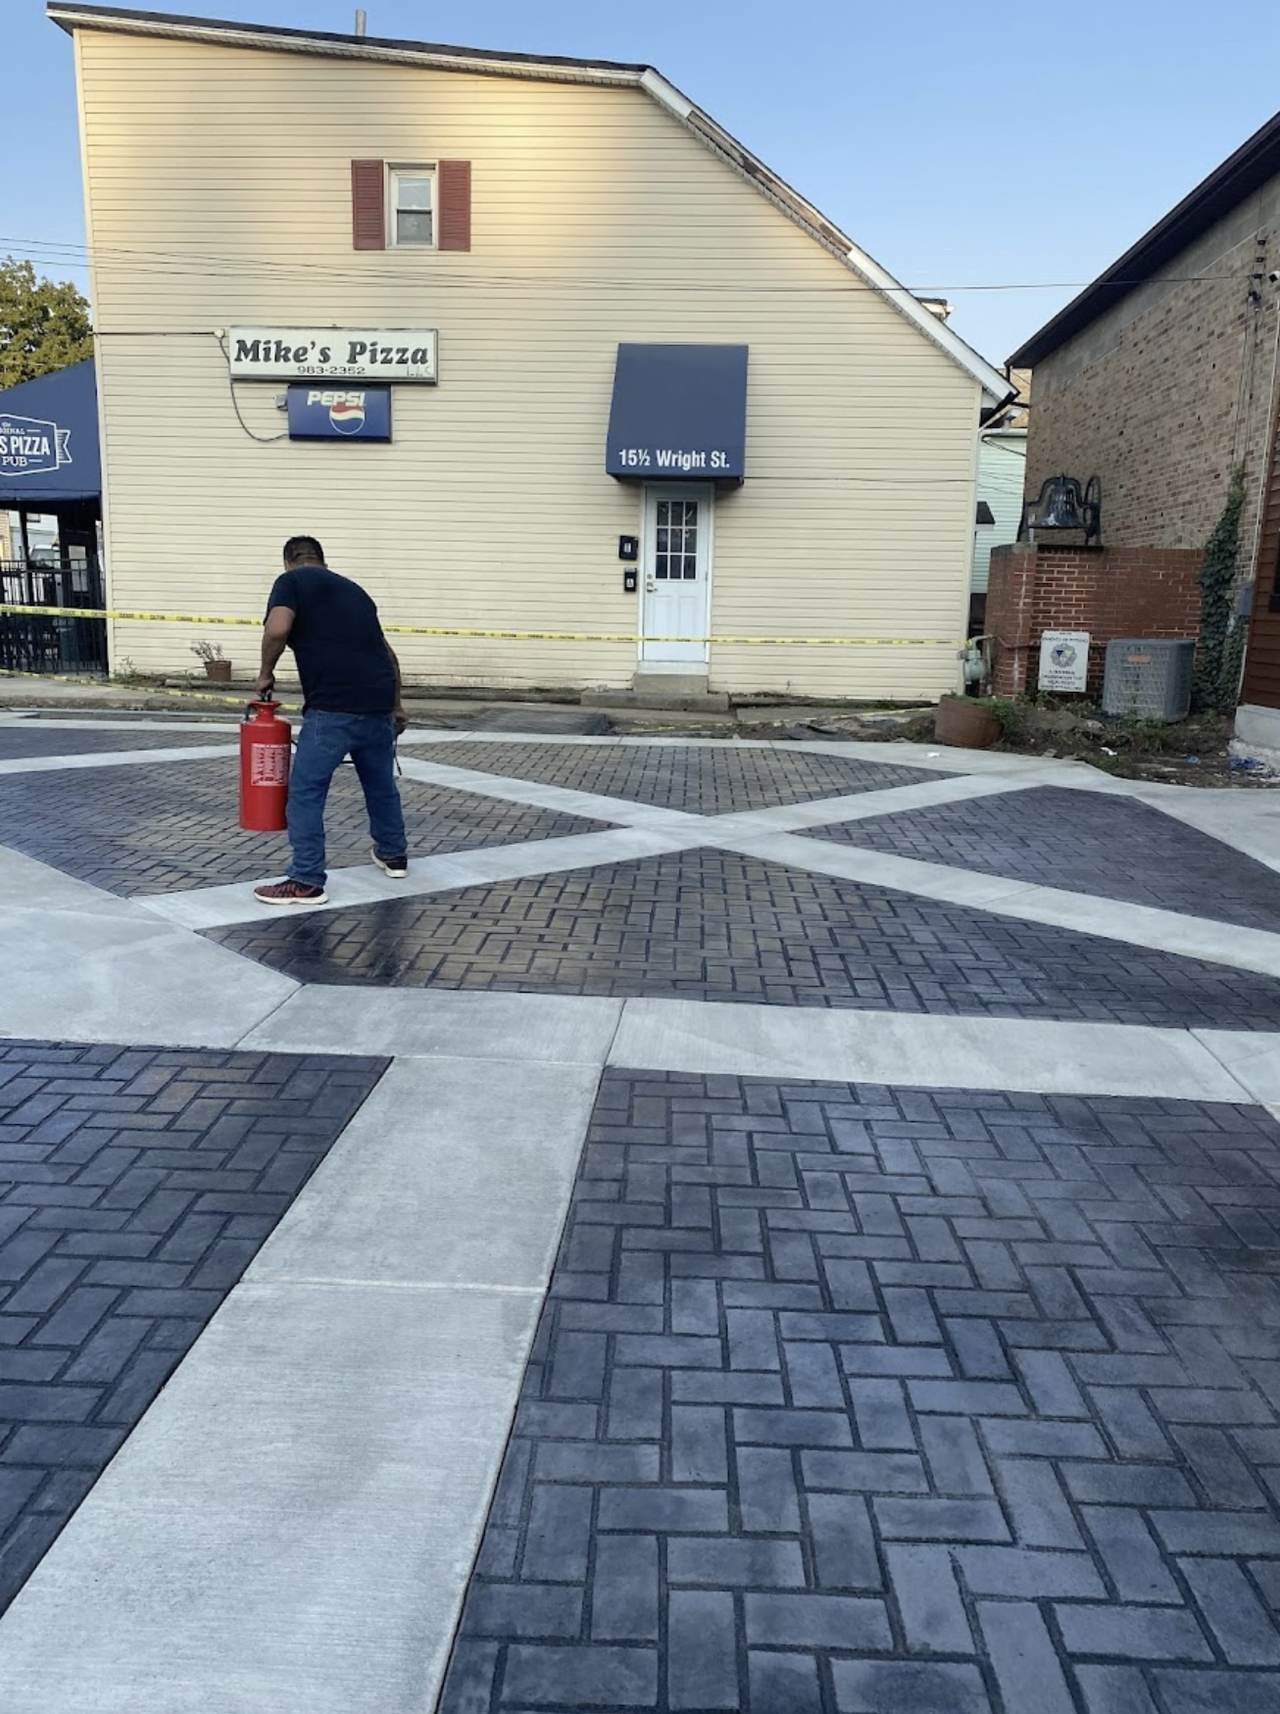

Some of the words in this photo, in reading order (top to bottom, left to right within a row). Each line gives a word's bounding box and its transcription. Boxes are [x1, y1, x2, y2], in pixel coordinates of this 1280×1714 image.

[234, 339, 331, 364] Mike's
[346, 341, 429, 365] Pizza
[307, 391, 366, 406] PEPSI
[10, 435, 51, 455] PIZZA
[2, 456, 28, 467] PUB
[656, 450, 706, 471] Wright
[710, 450, 730, 468] St.
